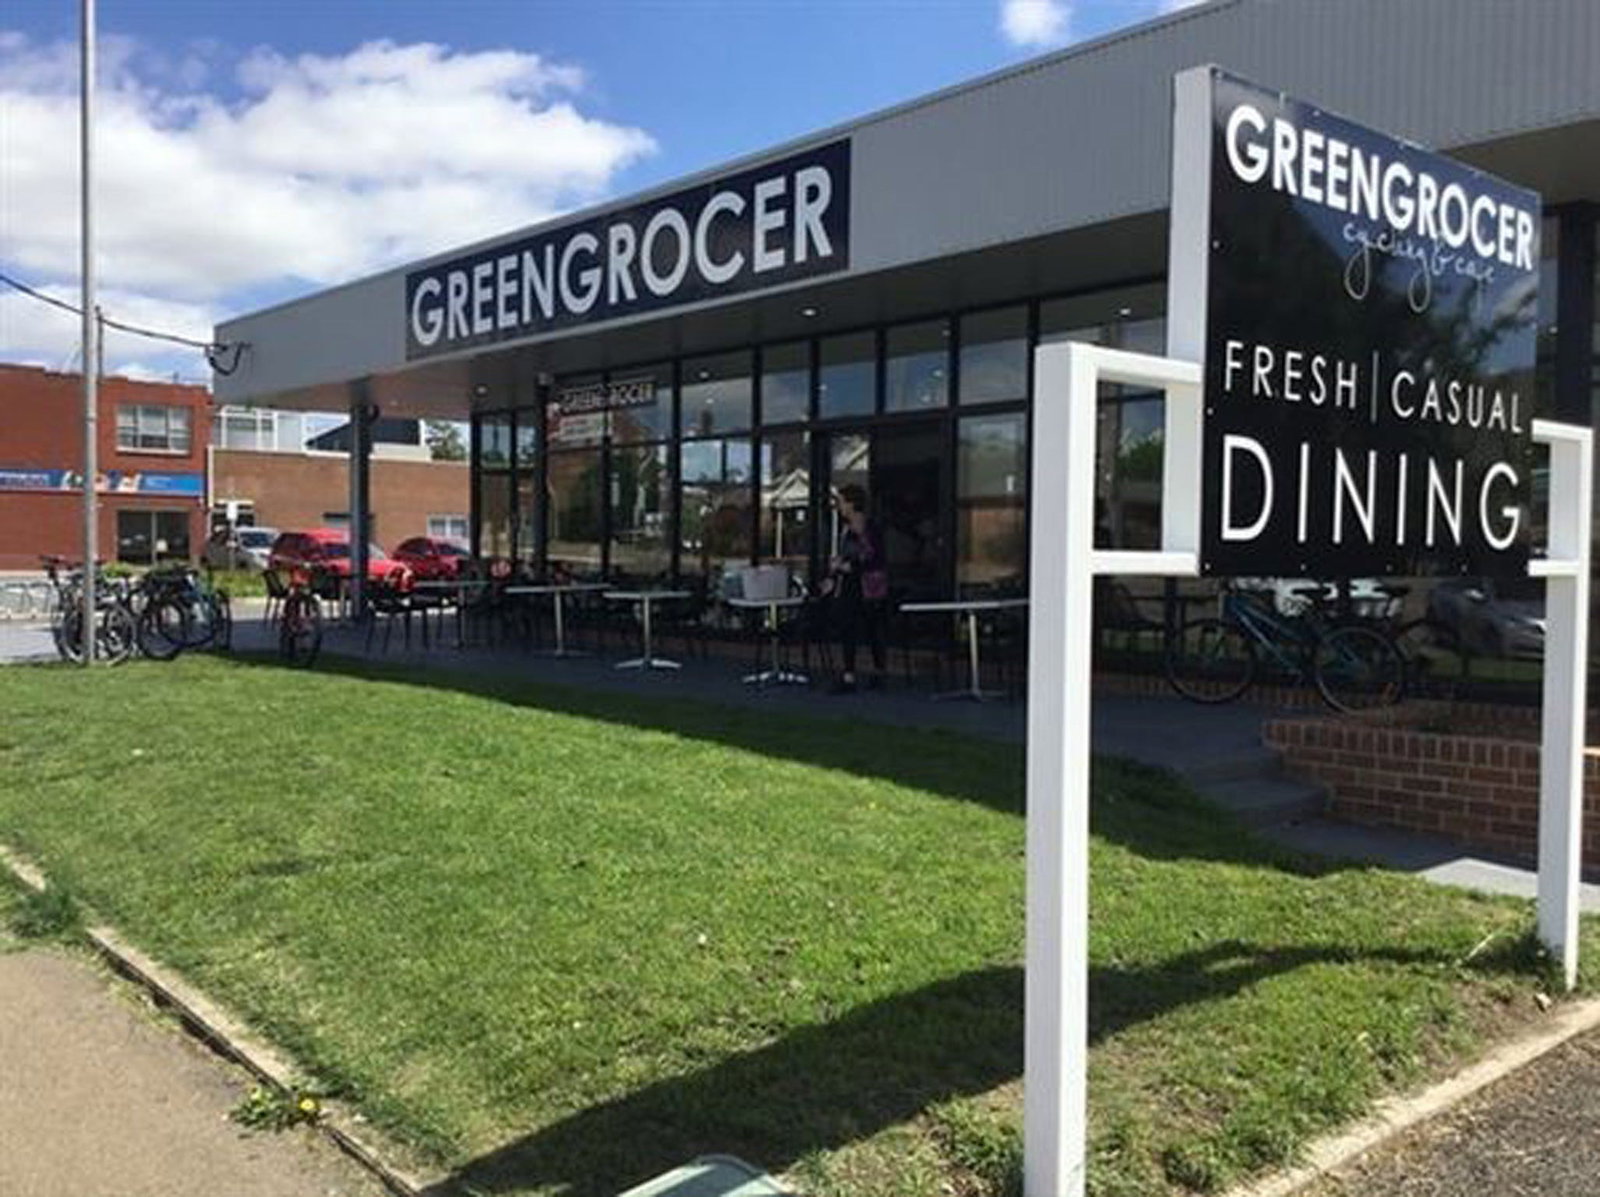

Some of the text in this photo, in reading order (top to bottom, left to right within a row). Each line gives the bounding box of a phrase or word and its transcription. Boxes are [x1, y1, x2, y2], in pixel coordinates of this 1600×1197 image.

[411, 165, 833, 346] GREENGROCER
[1226, 105, 1534, 270] GREENGROCER
[1225, 340, 1523, 433] FRESH CASUAL
[1221, 434, 1521, 549] DINING
